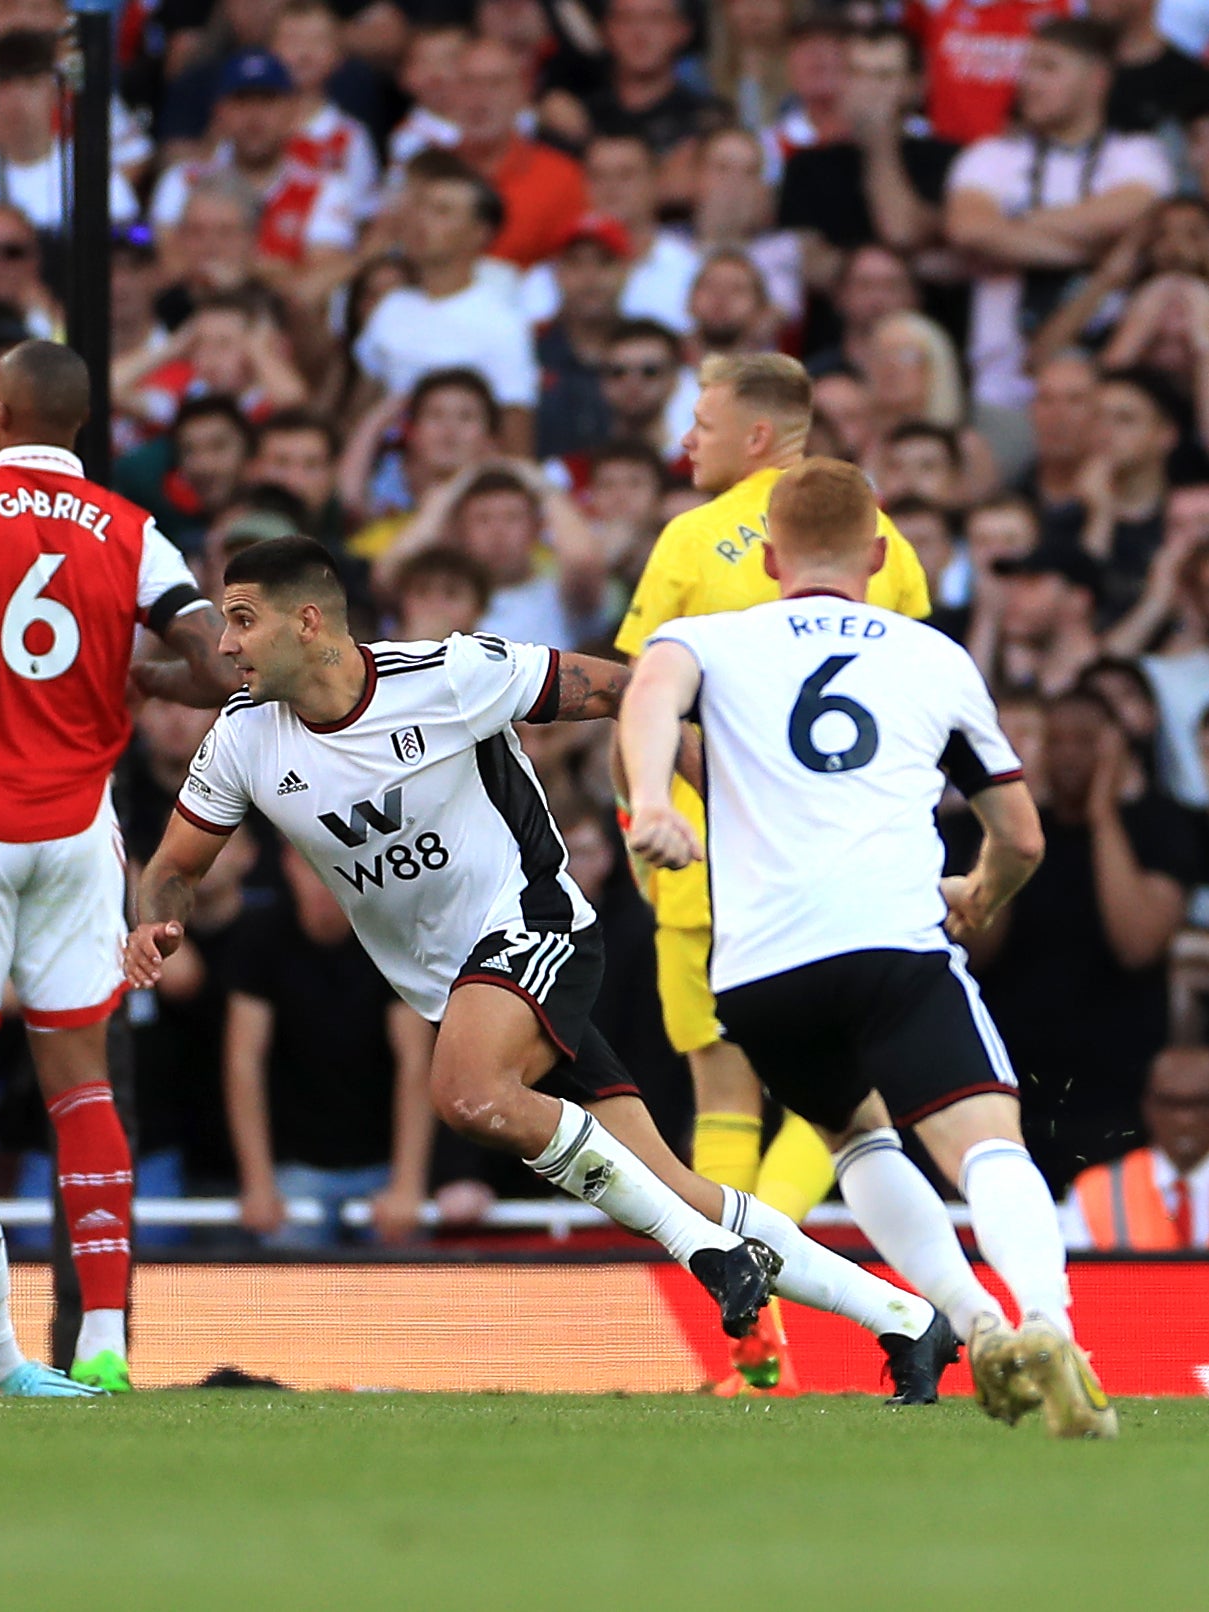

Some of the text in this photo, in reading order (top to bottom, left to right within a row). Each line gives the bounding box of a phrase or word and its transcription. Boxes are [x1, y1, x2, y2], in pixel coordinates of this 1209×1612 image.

[716, 513, 769, 564] RA
[0, 553, 82, 681] 6
[788, 615, 888, 639] REED
[788, 653, 880, 773] 6
[277, 782, 309, 796] adidas
[333, 831, 450, 896] W88
